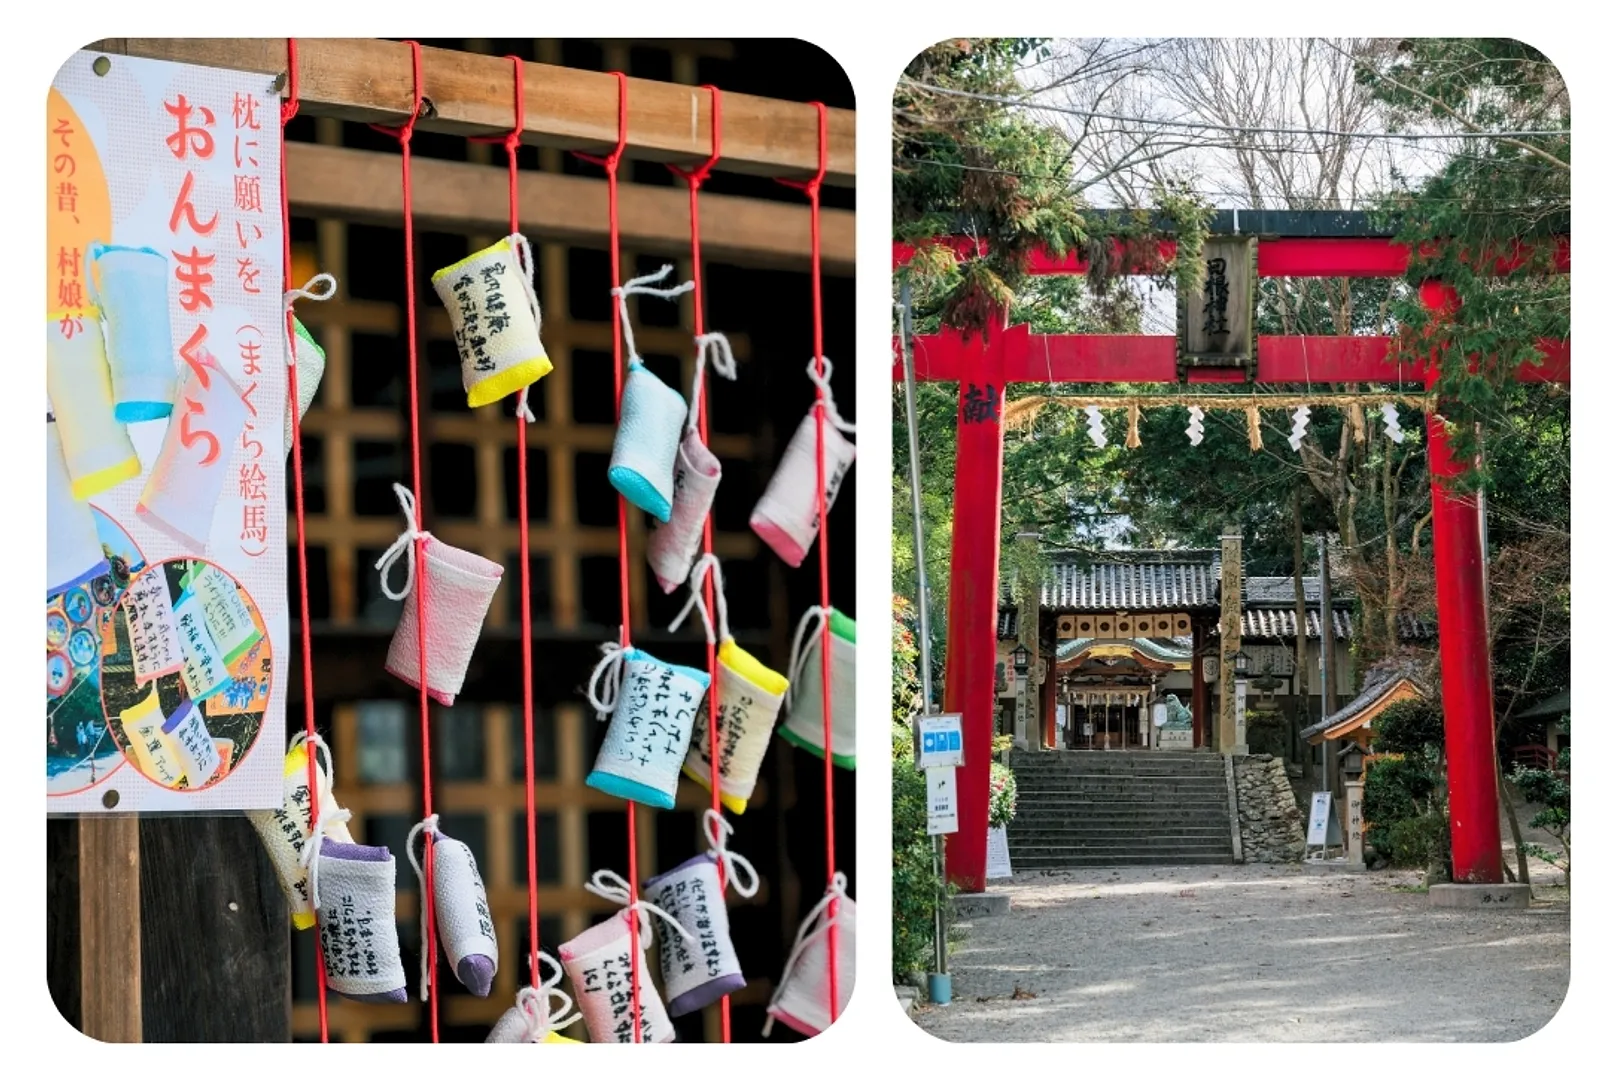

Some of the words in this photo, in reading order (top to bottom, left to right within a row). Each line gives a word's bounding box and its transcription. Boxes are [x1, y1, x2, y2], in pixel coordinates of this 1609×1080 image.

[162, 92, 222, 468] おんまくら
[231, 91, 263, 294] 枕に願いを
